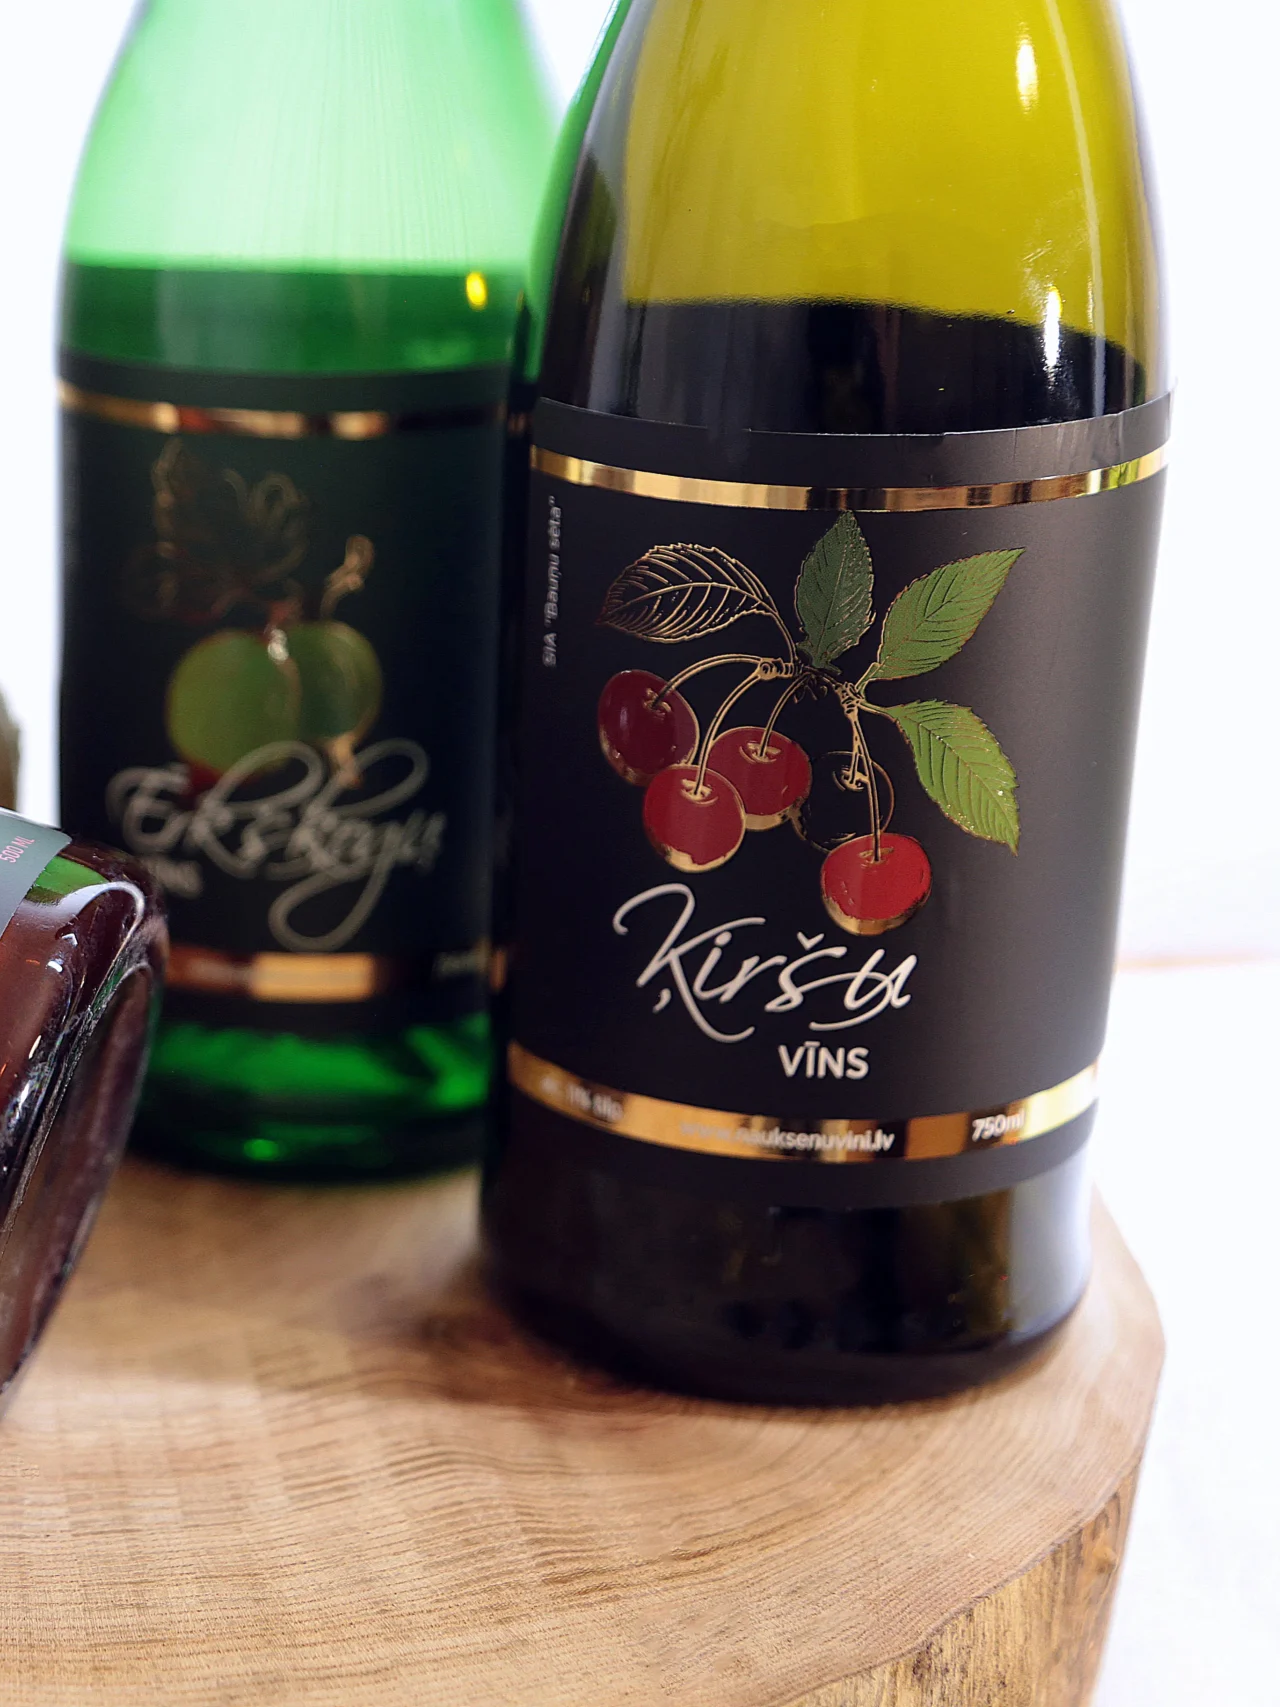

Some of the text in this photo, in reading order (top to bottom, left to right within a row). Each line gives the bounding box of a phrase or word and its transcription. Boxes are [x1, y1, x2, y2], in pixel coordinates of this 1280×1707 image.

[542, 632, 558, 668] SIA
[612, 882, 918, 1044] Ķiršu
[778, 1040, 870, 1081] VĪNS
[971, 1107, 1026, 1143] 750ml
